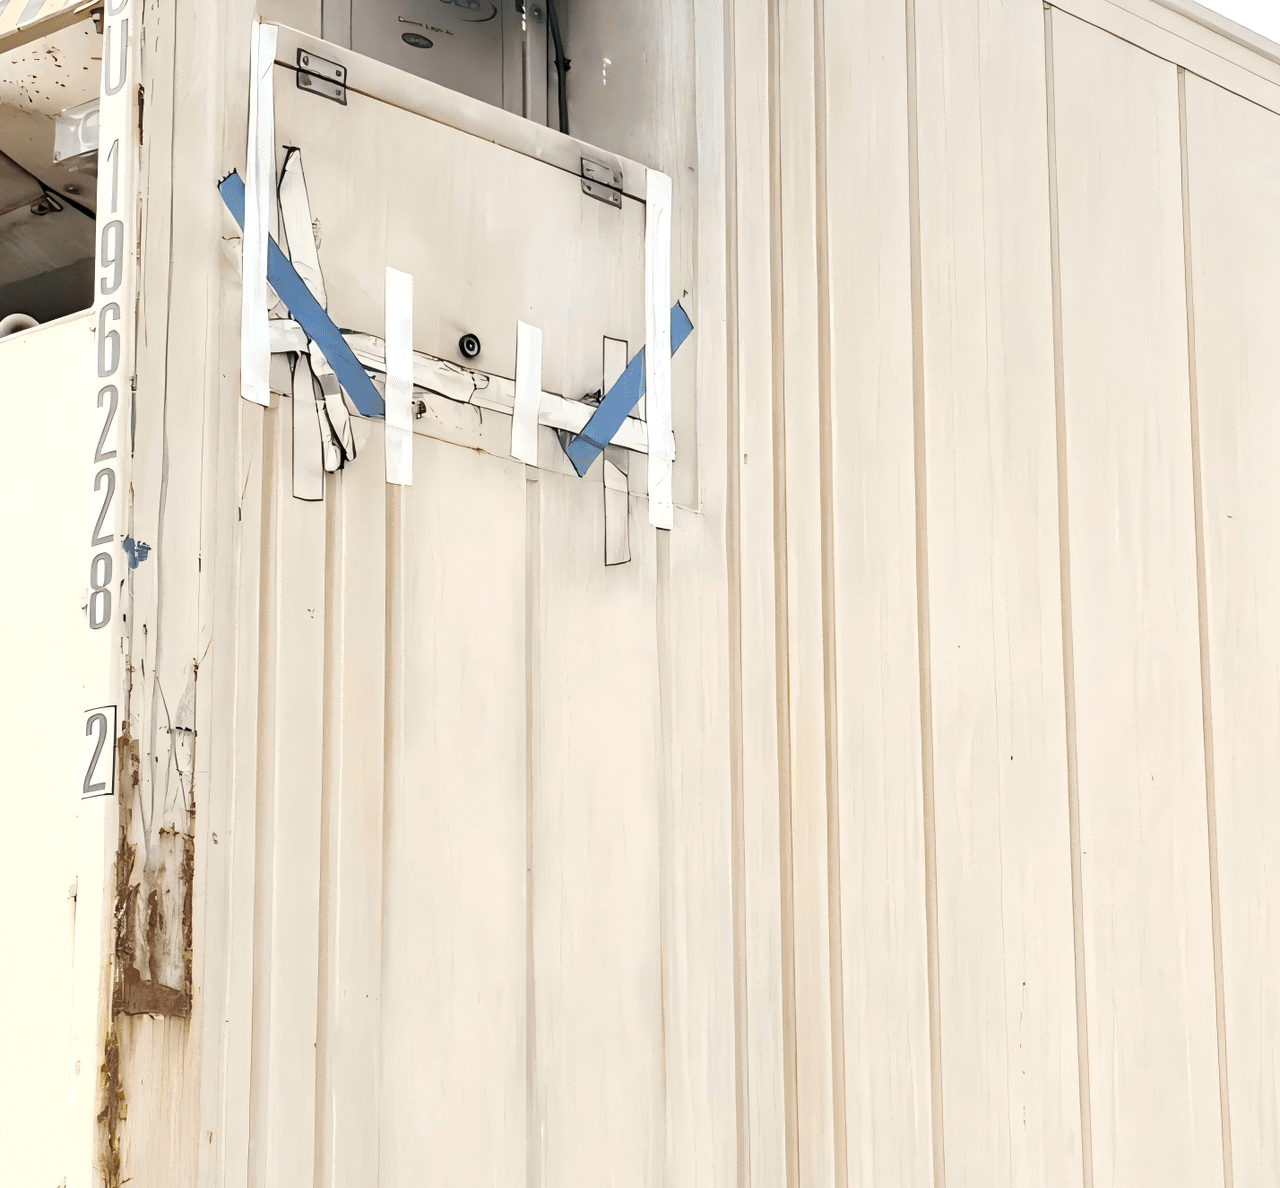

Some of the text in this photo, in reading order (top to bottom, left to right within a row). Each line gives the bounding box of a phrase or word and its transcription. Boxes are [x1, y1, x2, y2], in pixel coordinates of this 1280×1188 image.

[83, 0, 130, 794] U 196228 2
